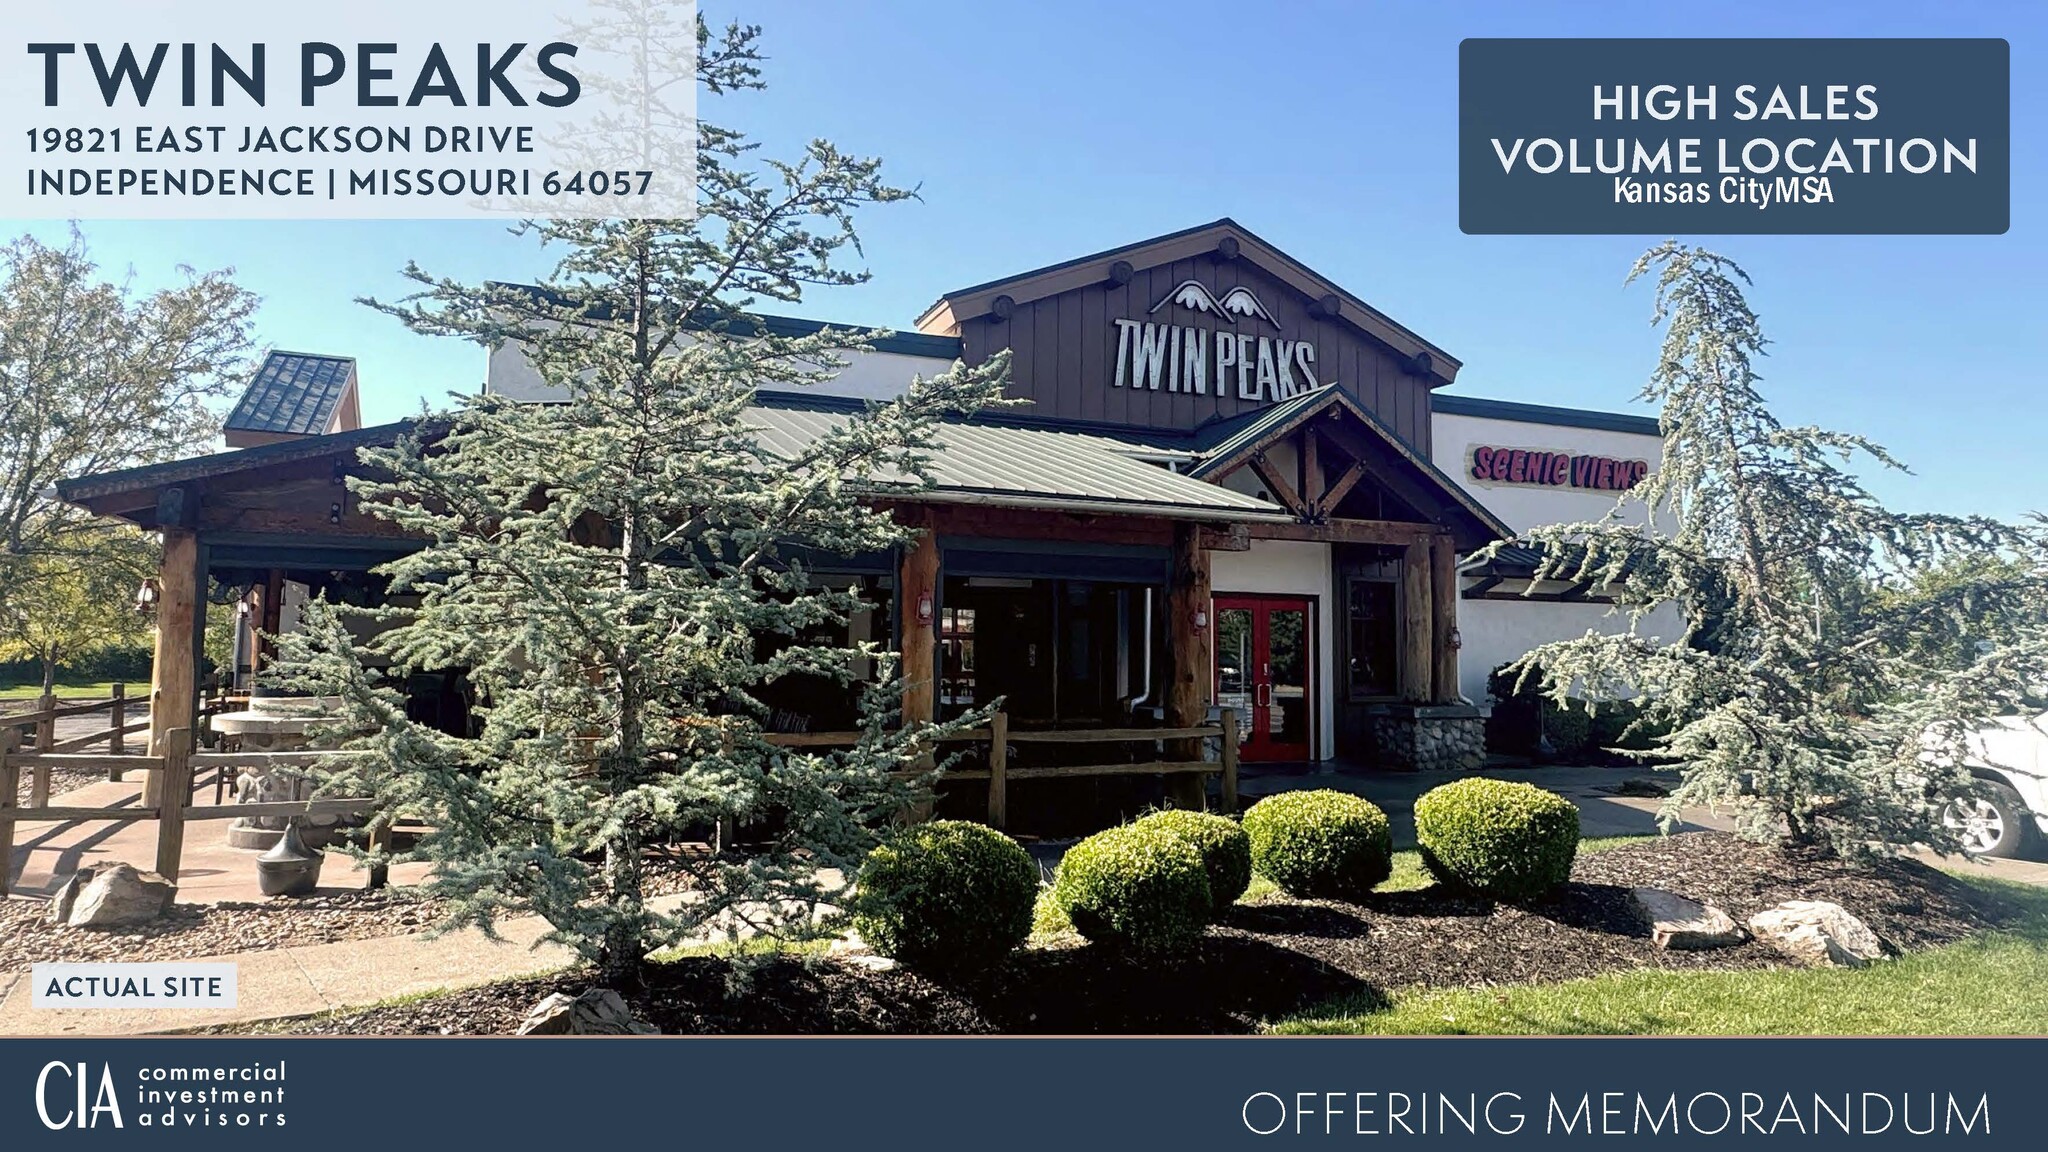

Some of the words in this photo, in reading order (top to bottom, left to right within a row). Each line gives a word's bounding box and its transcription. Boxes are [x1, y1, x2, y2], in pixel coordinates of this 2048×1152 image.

[1114, 318, 1207, 394] TWIN
[1216, 331, 1318, 401] PEAKS
[1472, 446, 1570, 486] SCENIC
